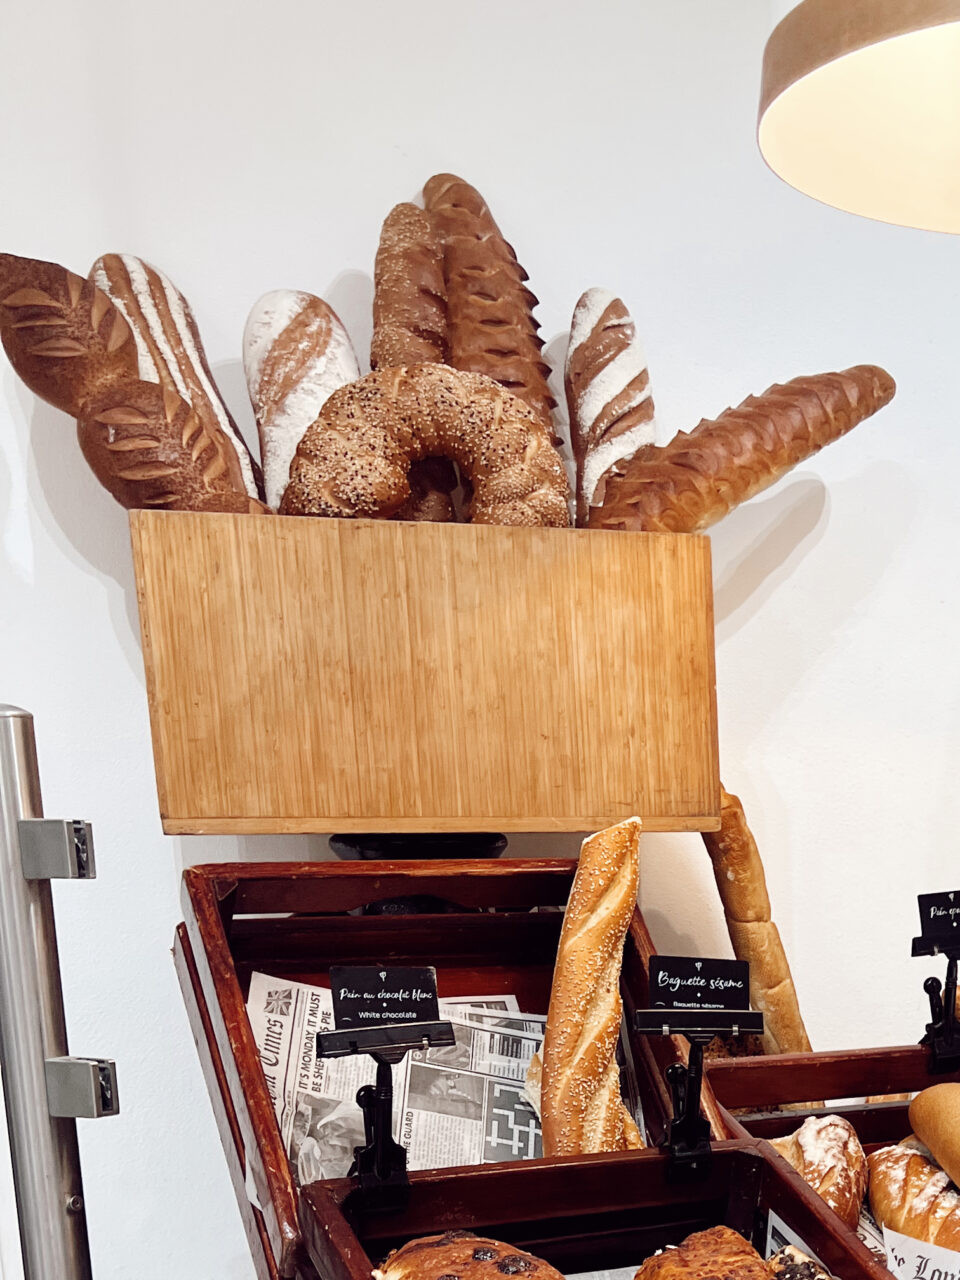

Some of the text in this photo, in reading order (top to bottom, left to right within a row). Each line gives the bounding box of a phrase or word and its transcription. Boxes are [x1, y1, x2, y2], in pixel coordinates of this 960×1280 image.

[929, 906, 948, 919] Pain
[657, 970, 744, 991] Baguette sésame
[308, 991, 321, 1019] MUST
[340, 987, 361, 1001] Pain
[377, 988, 410, 1002] chocolat
[411, 988, 433, 1002] blanc
[358, 1011, 417, 1019] White chocolate
[311, 1082, 322, 1094] BE
[322, 1010, 332, 1026] PIE
[403, 1111, 414, 1139] GUARD
